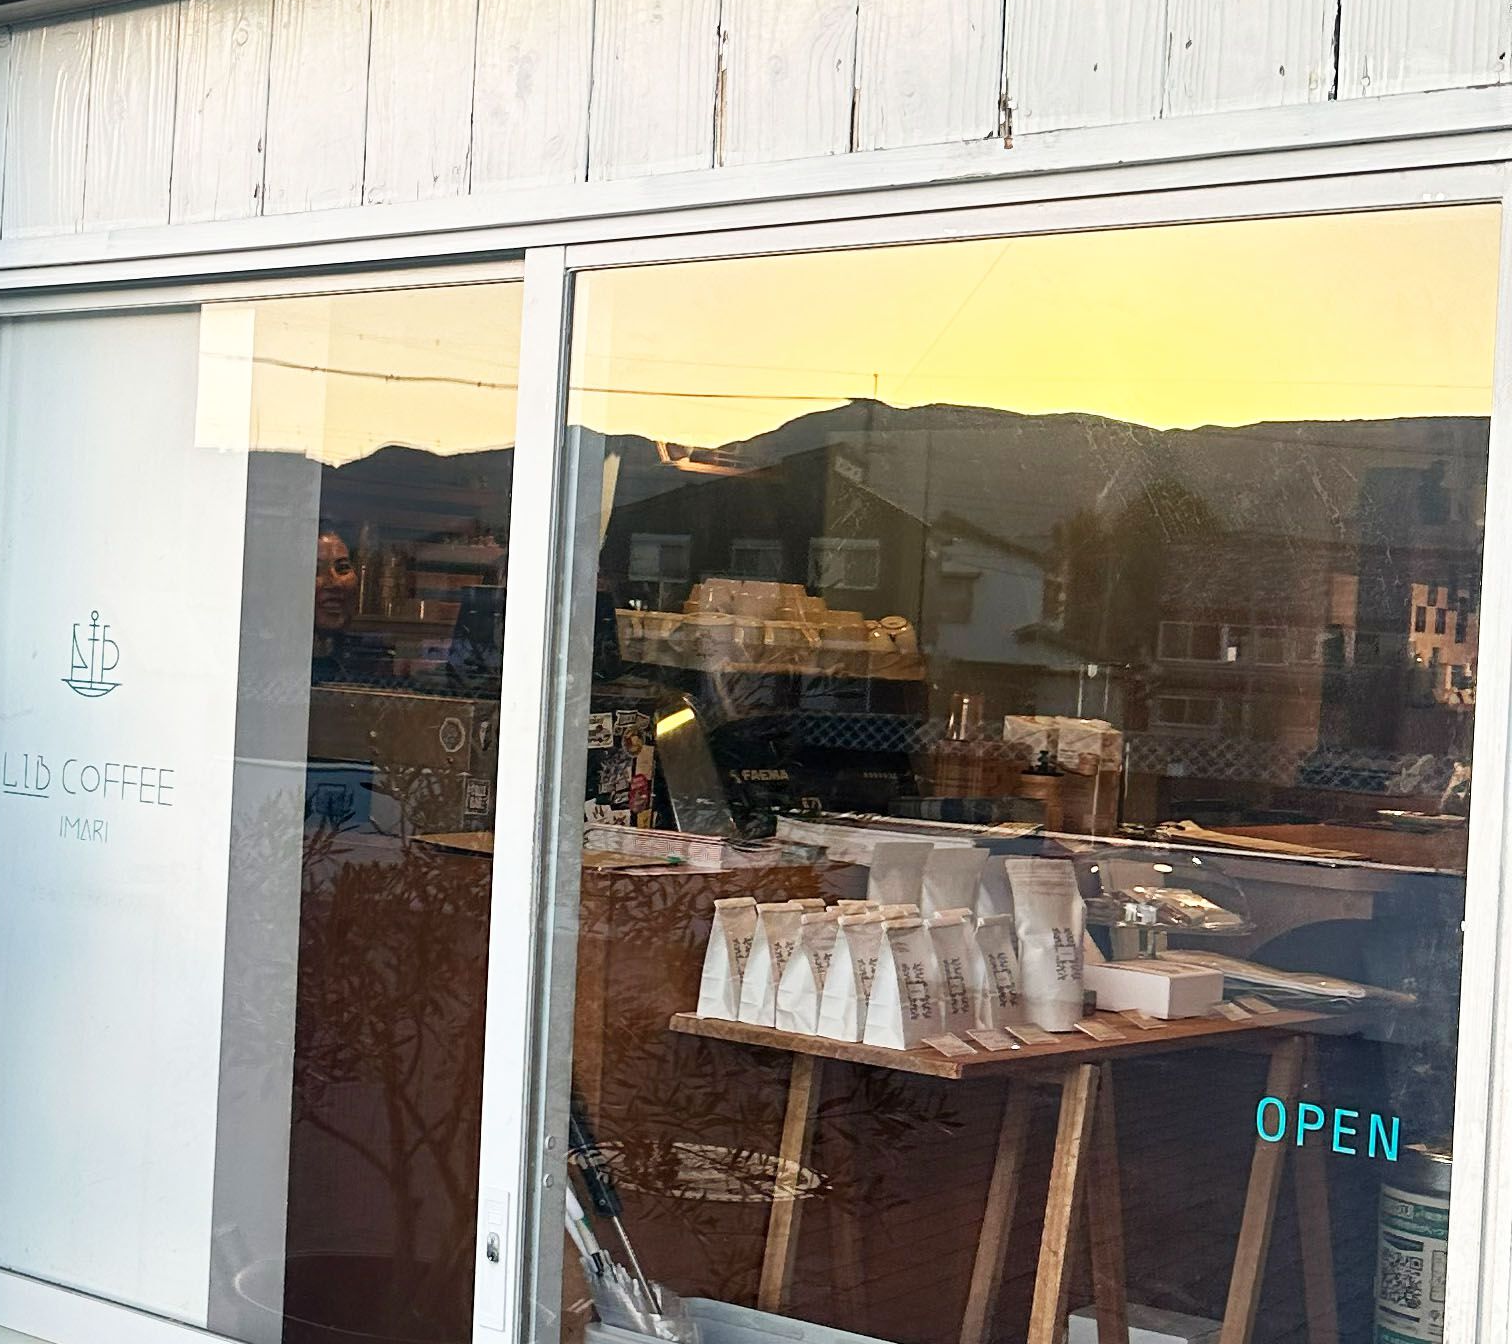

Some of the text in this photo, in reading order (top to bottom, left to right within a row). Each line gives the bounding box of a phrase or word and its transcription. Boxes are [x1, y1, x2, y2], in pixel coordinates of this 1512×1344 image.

[2, 751, 175, 807] LIB COFFEE
[58, 815, 109, 844] IMARI
[1255, 1095, 1401, 1162] OPEN
